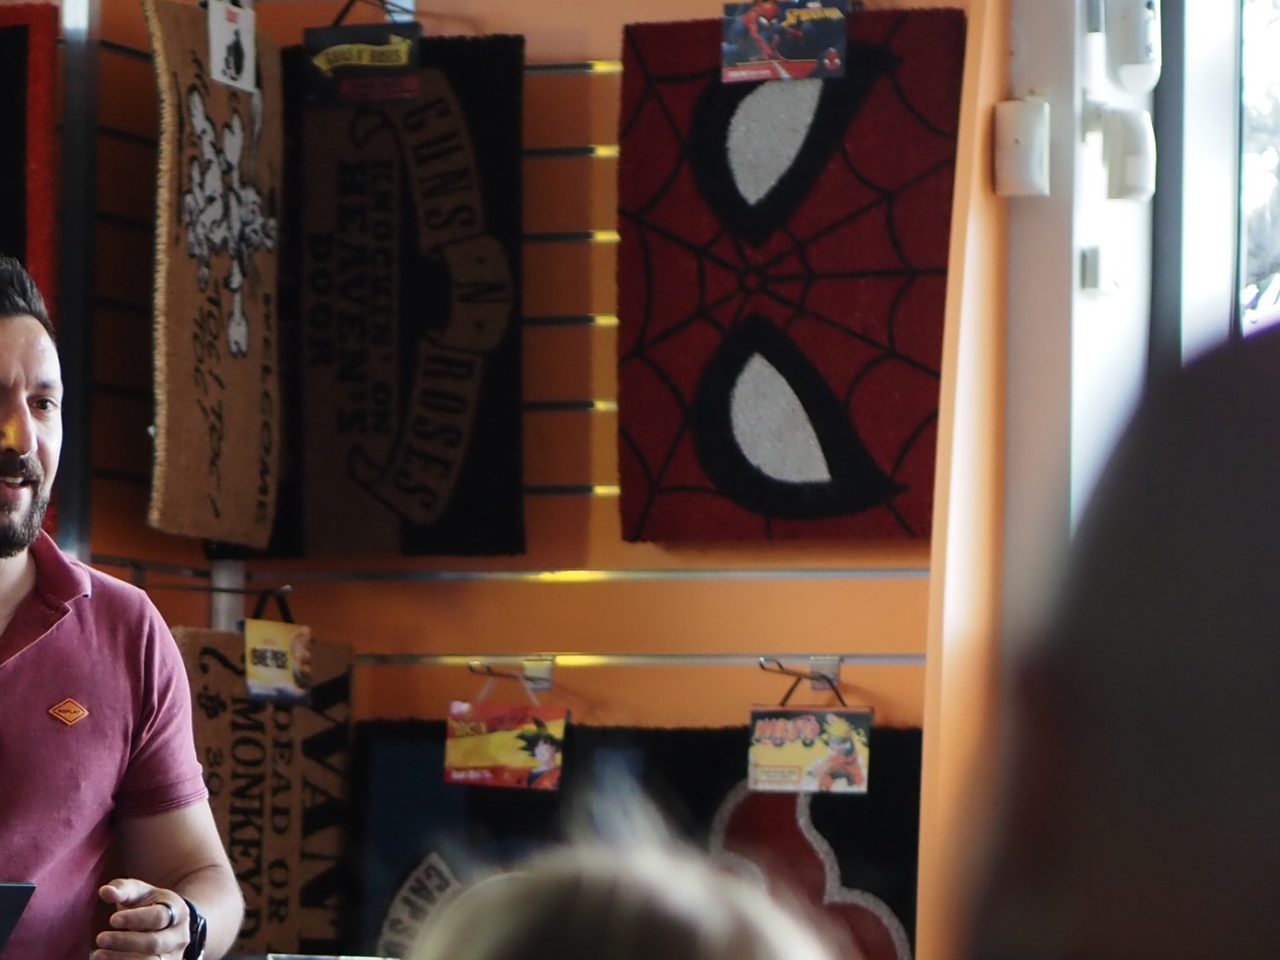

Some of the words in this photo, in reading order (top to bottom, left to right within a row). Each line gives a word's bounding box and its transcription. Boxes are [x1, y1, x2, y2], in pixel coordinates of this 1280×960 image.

[404, 96, 475, 234] GUNS
[306, 232, 335, 368] DOOR
[336, 158, 371, 435] HEAVEN'S
[255, 290, 276, 527] WELCOME
[371, 382, 394, 434] ON
[392, 350, 475, 515] ROSES
[229, 696, 266, 896] MONKEY
[271, 703, 294, 835] DEAD
[267, 858, 290, 924] OR
